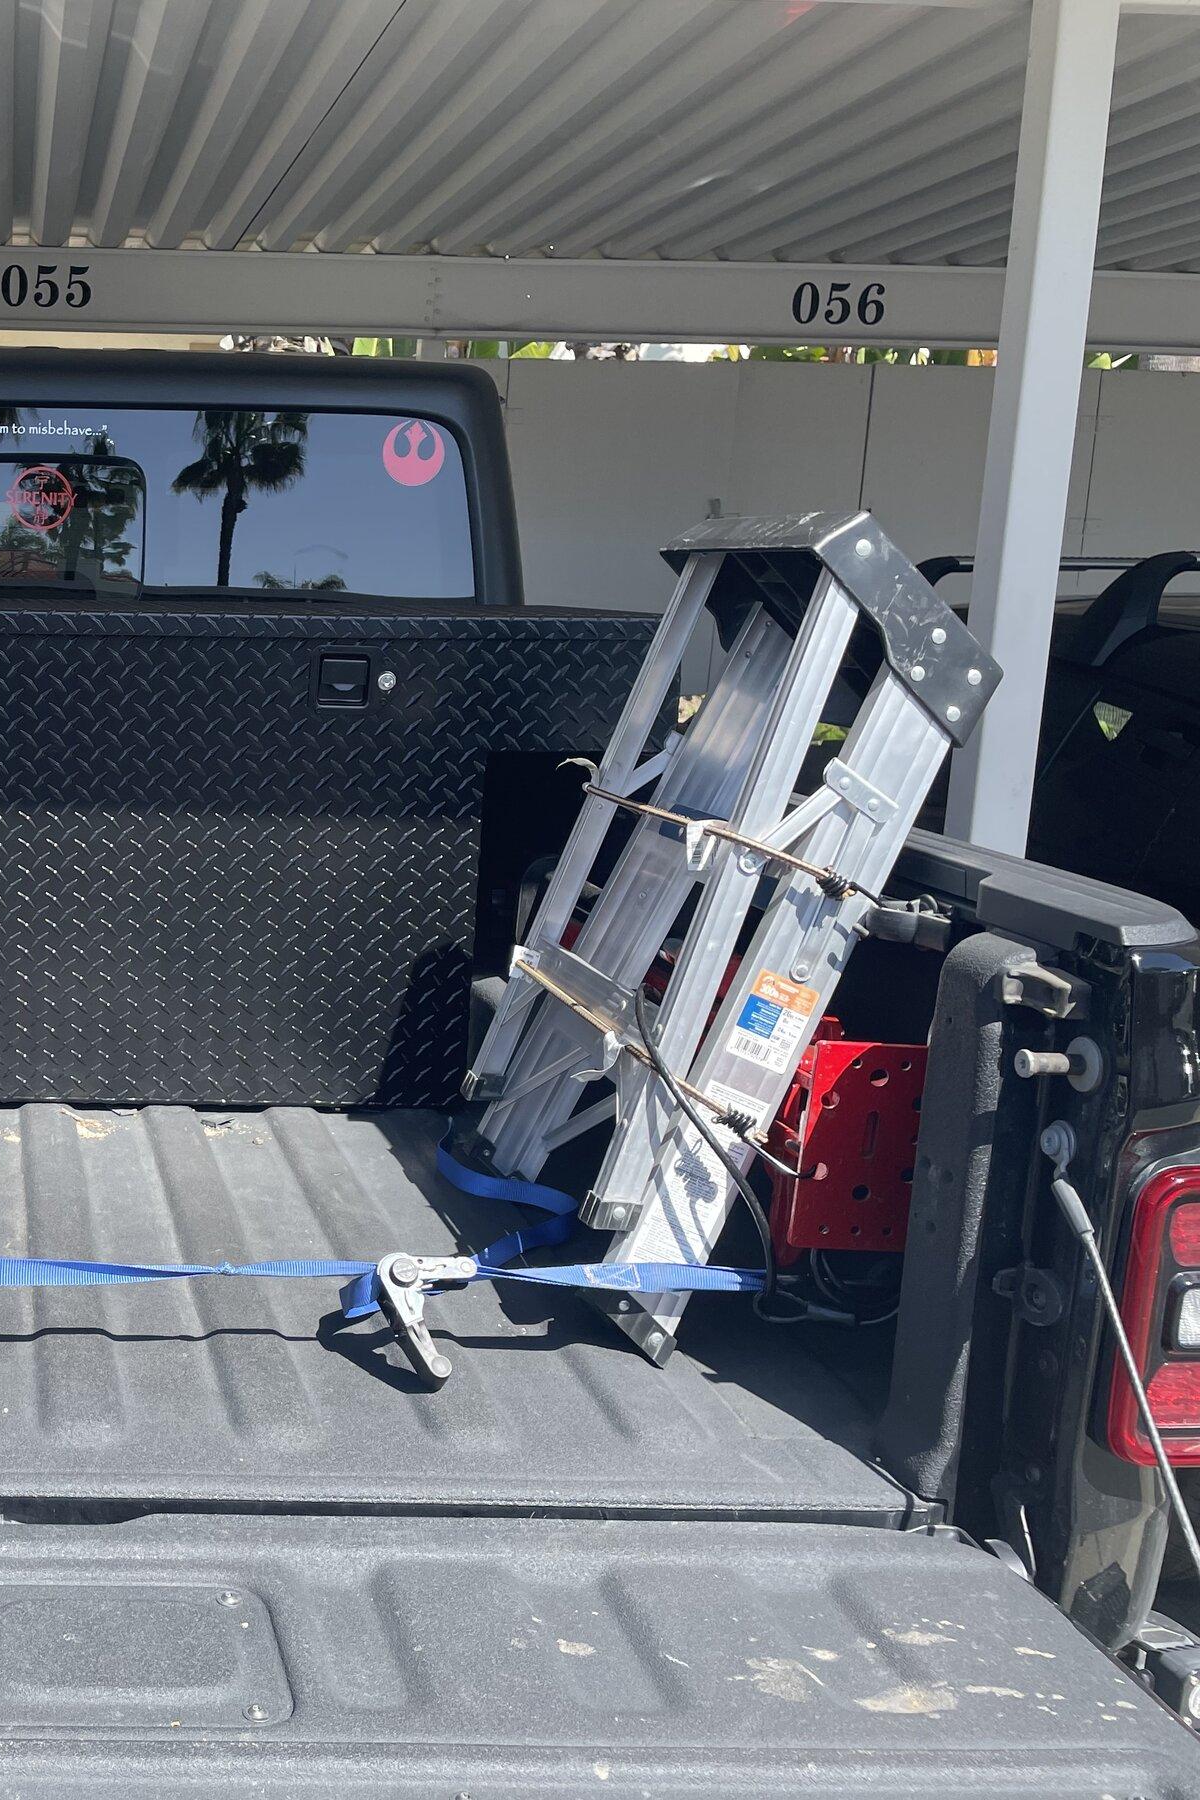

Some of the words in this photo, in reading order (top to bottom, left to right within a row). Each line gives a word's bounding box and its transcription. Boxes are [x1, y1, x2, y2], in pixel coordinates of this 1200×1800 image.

[1, 264, 91, 308] 055
[792, 282, 885, 325] 056
[12, 423, 26, 434] to
[6, 487, 78, 507] SERENITY
